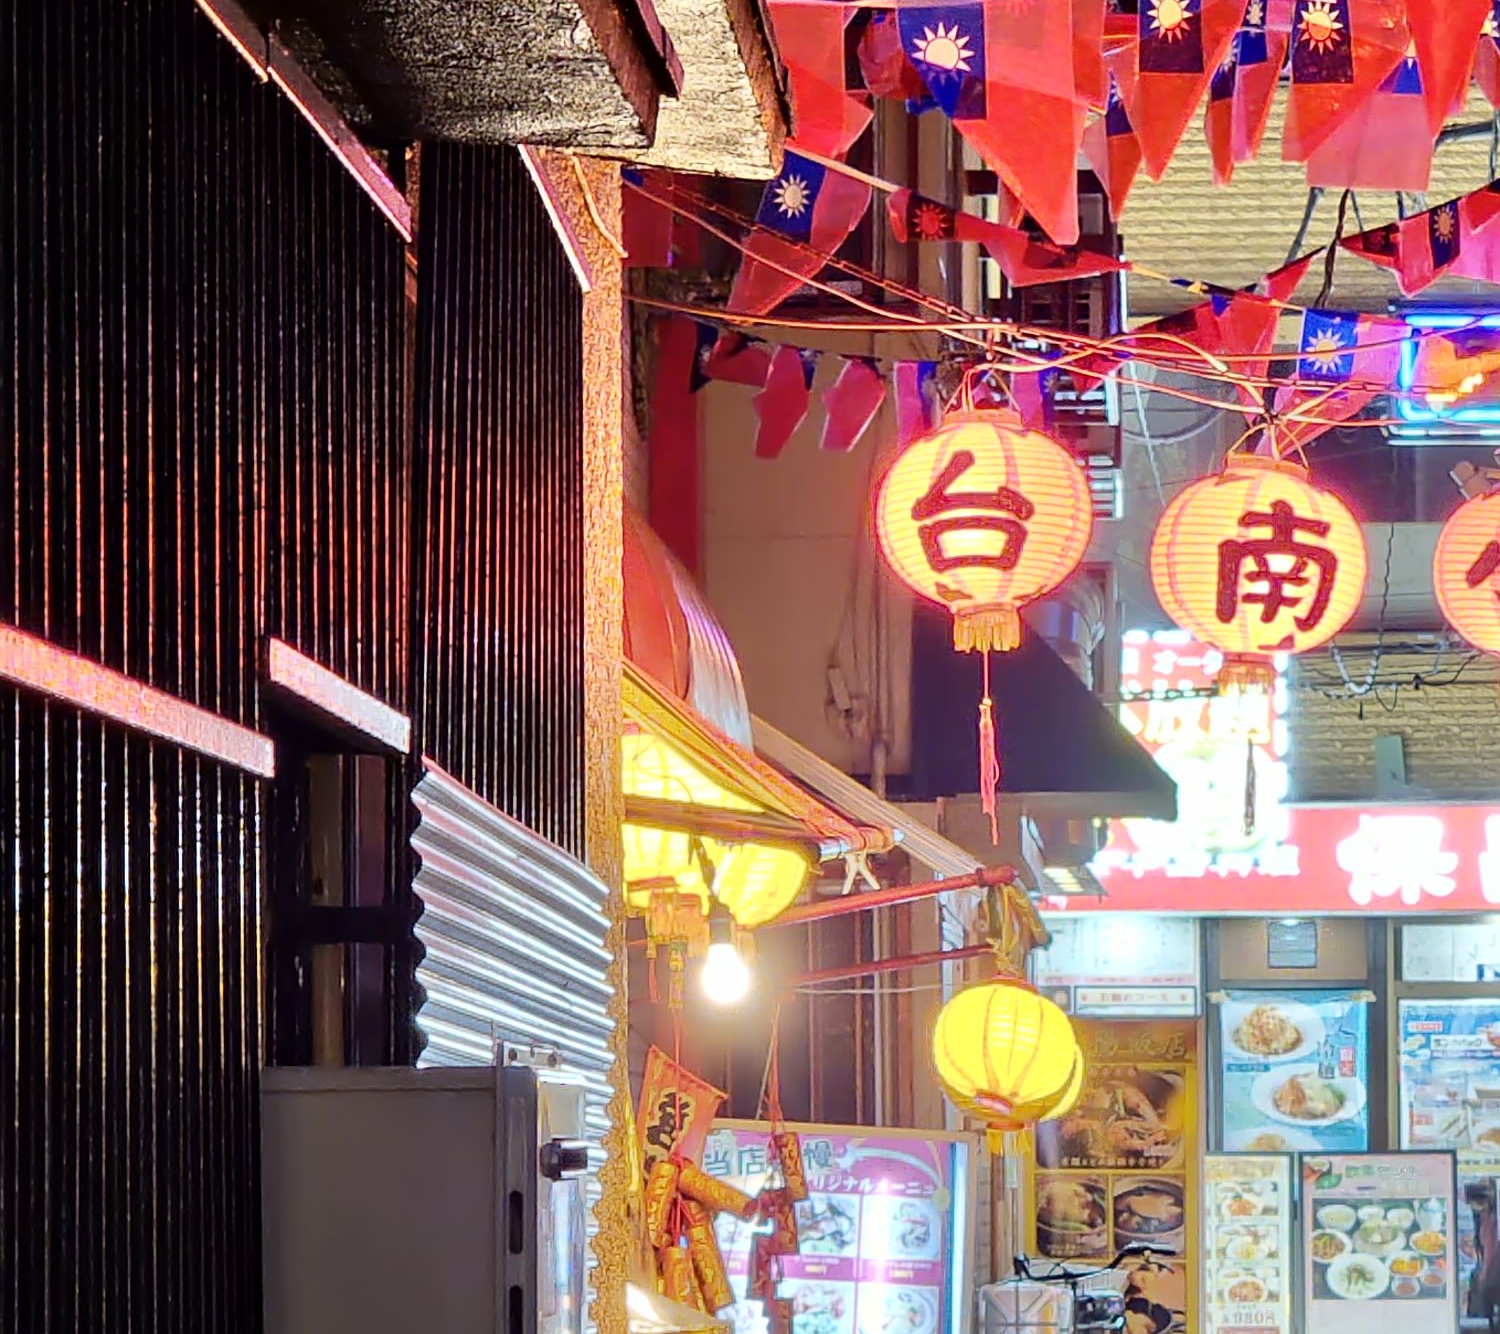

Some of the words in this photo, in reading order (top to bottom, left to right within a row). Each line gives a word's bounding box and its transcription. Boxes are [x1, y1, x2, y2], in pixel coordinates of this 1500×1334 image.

[911, 450, 1034, 573] 台
[1215, 499, 1339, 632] 南
[704, 1139, 833, 1176] 当店慢
